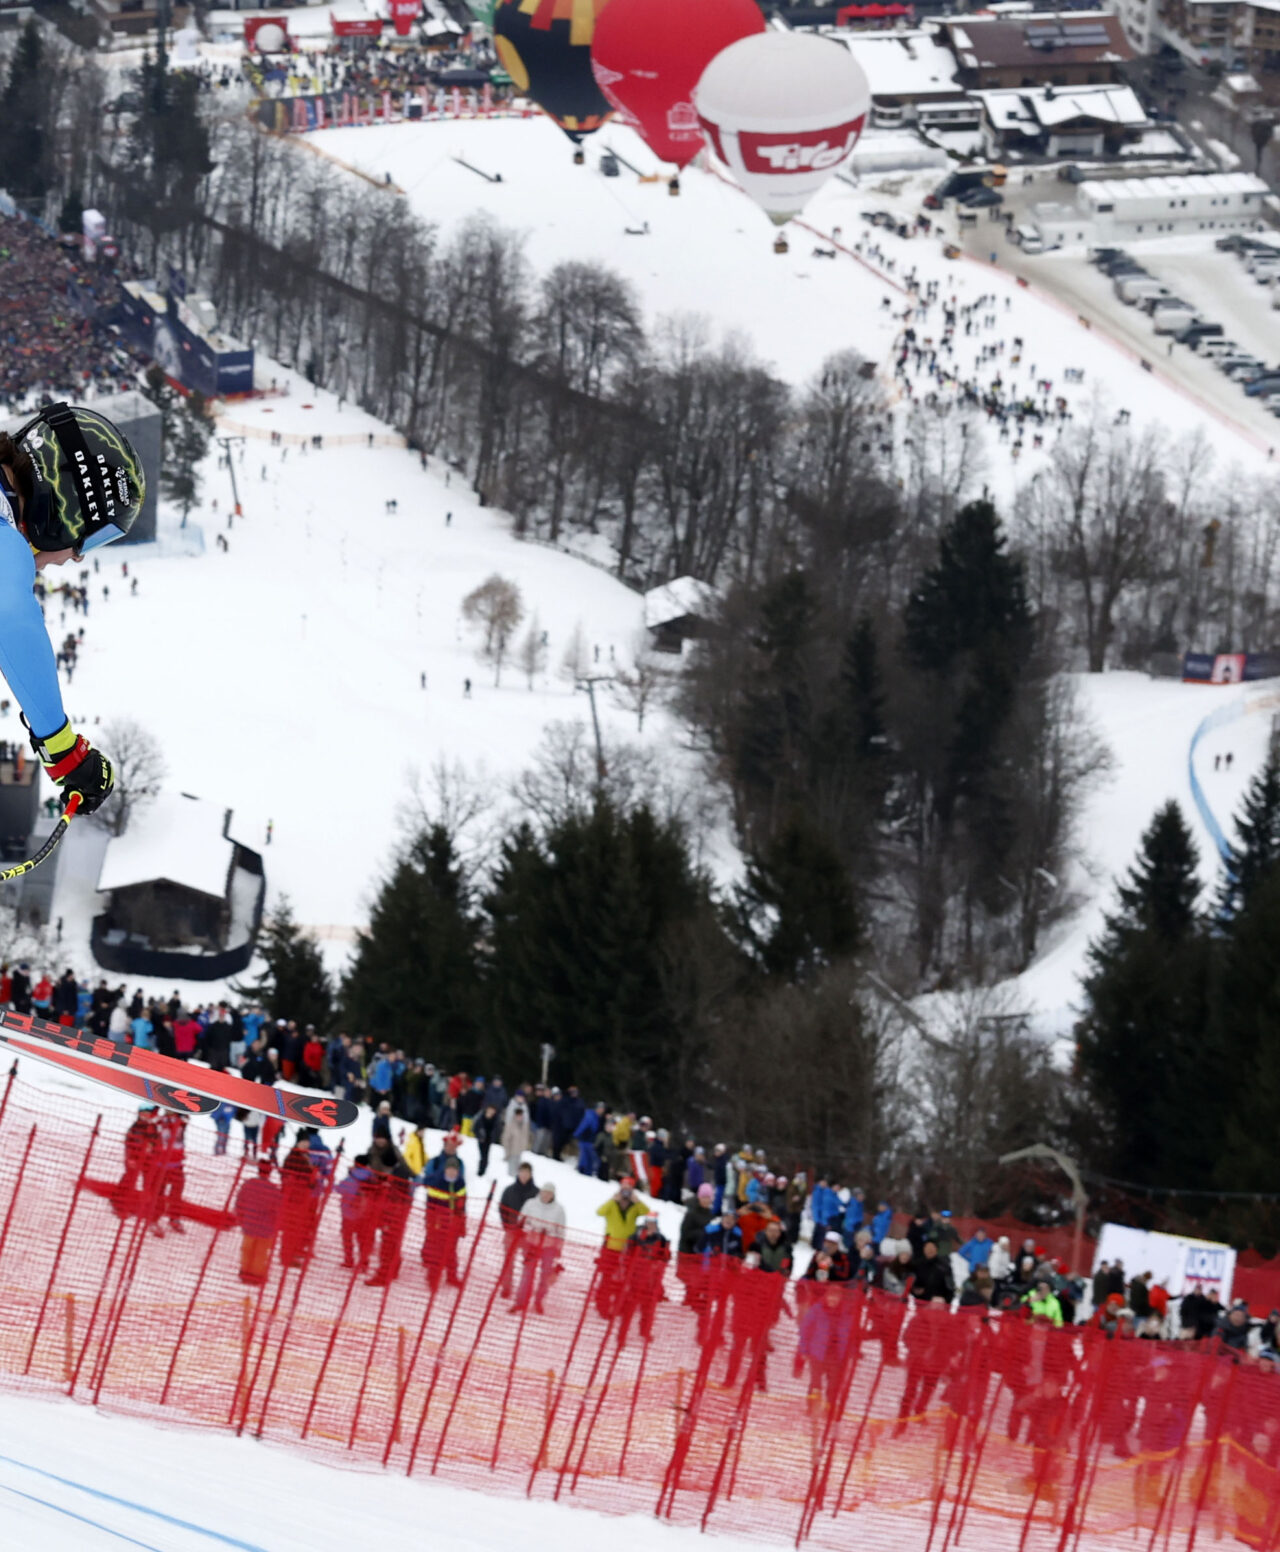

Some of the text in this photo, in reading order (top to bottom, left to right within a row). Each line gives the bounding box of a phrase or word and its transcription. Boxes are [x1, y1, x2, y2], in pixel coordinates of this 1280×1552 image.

[756, 131, 858, 170] Tirol
[74, 450, 101, 522] OAKLEY
[96, 454, 116, 517] OAKLEY
[1, 860, 35, 880] LEKI
